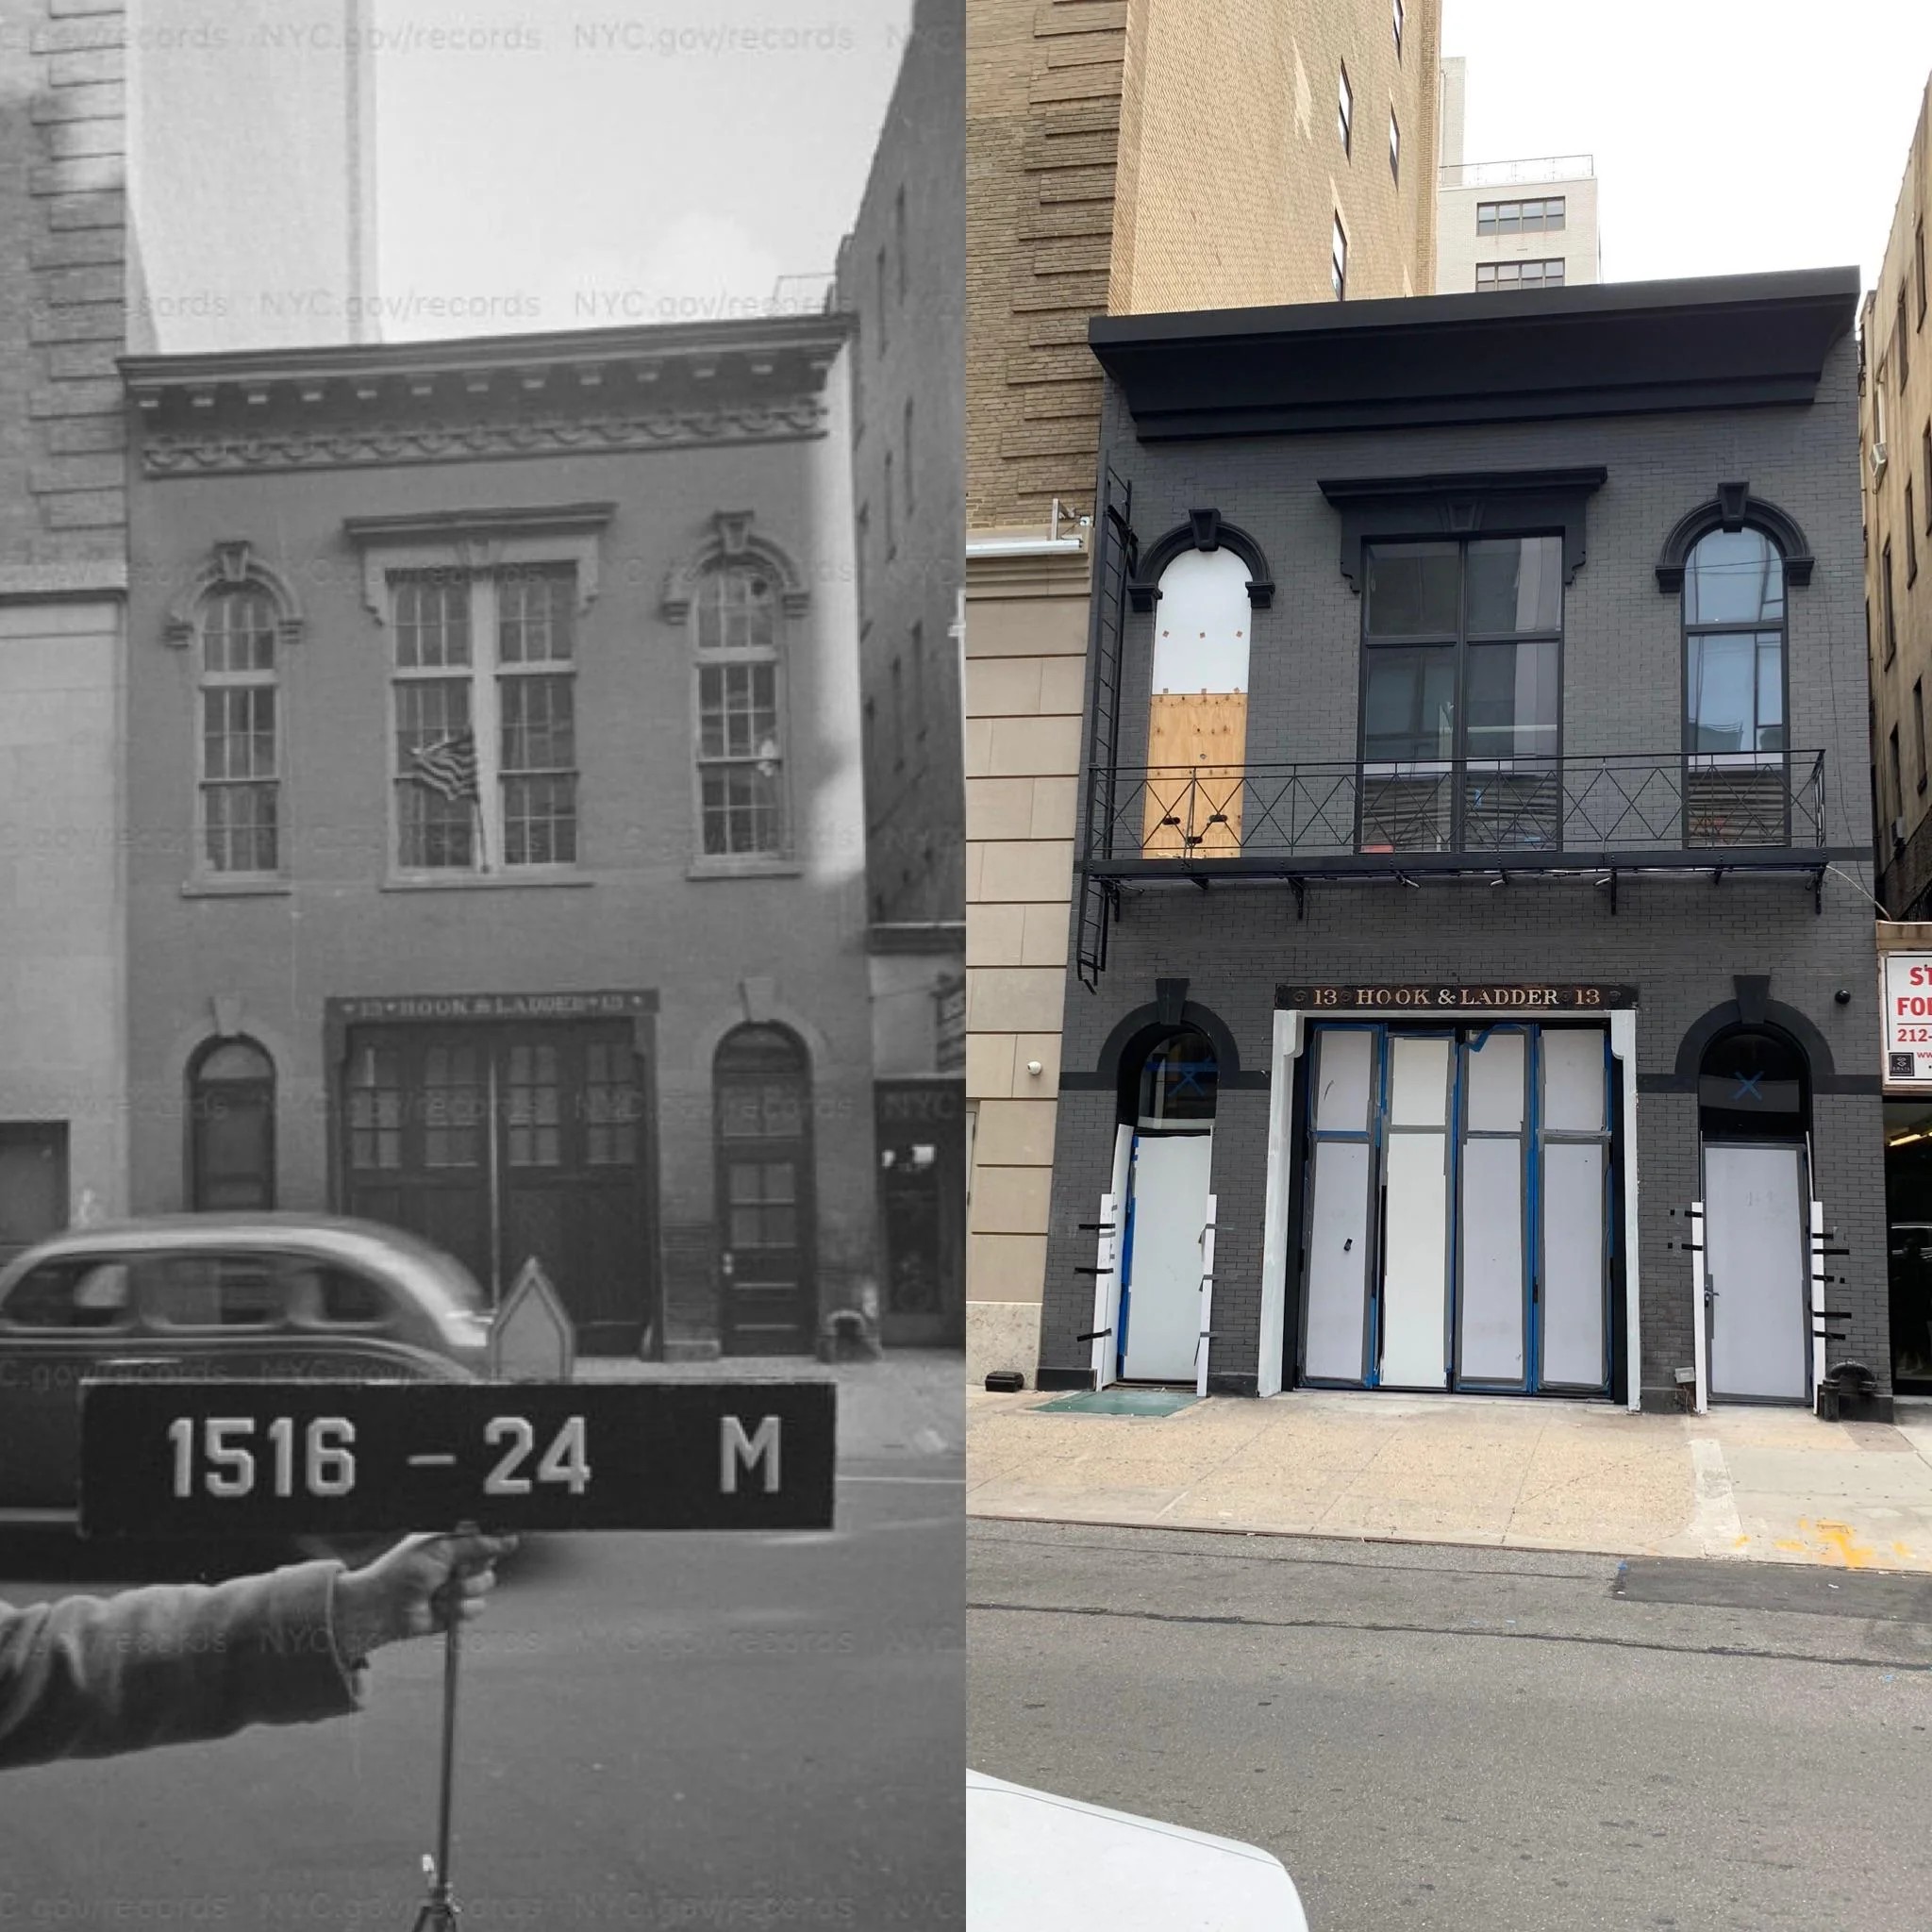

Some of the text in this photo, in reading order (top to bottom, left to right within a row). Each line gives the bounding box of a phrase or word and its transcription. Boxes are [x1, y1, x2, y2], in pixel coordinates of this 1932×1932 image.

[1314, 990, 1600, 1005] 13 HOOK & LADDER 13
[169, 1417, 356, 1497] 1516
[484, 1416, 591, 1494] 24
[720, 1416, 781, 1493] M
